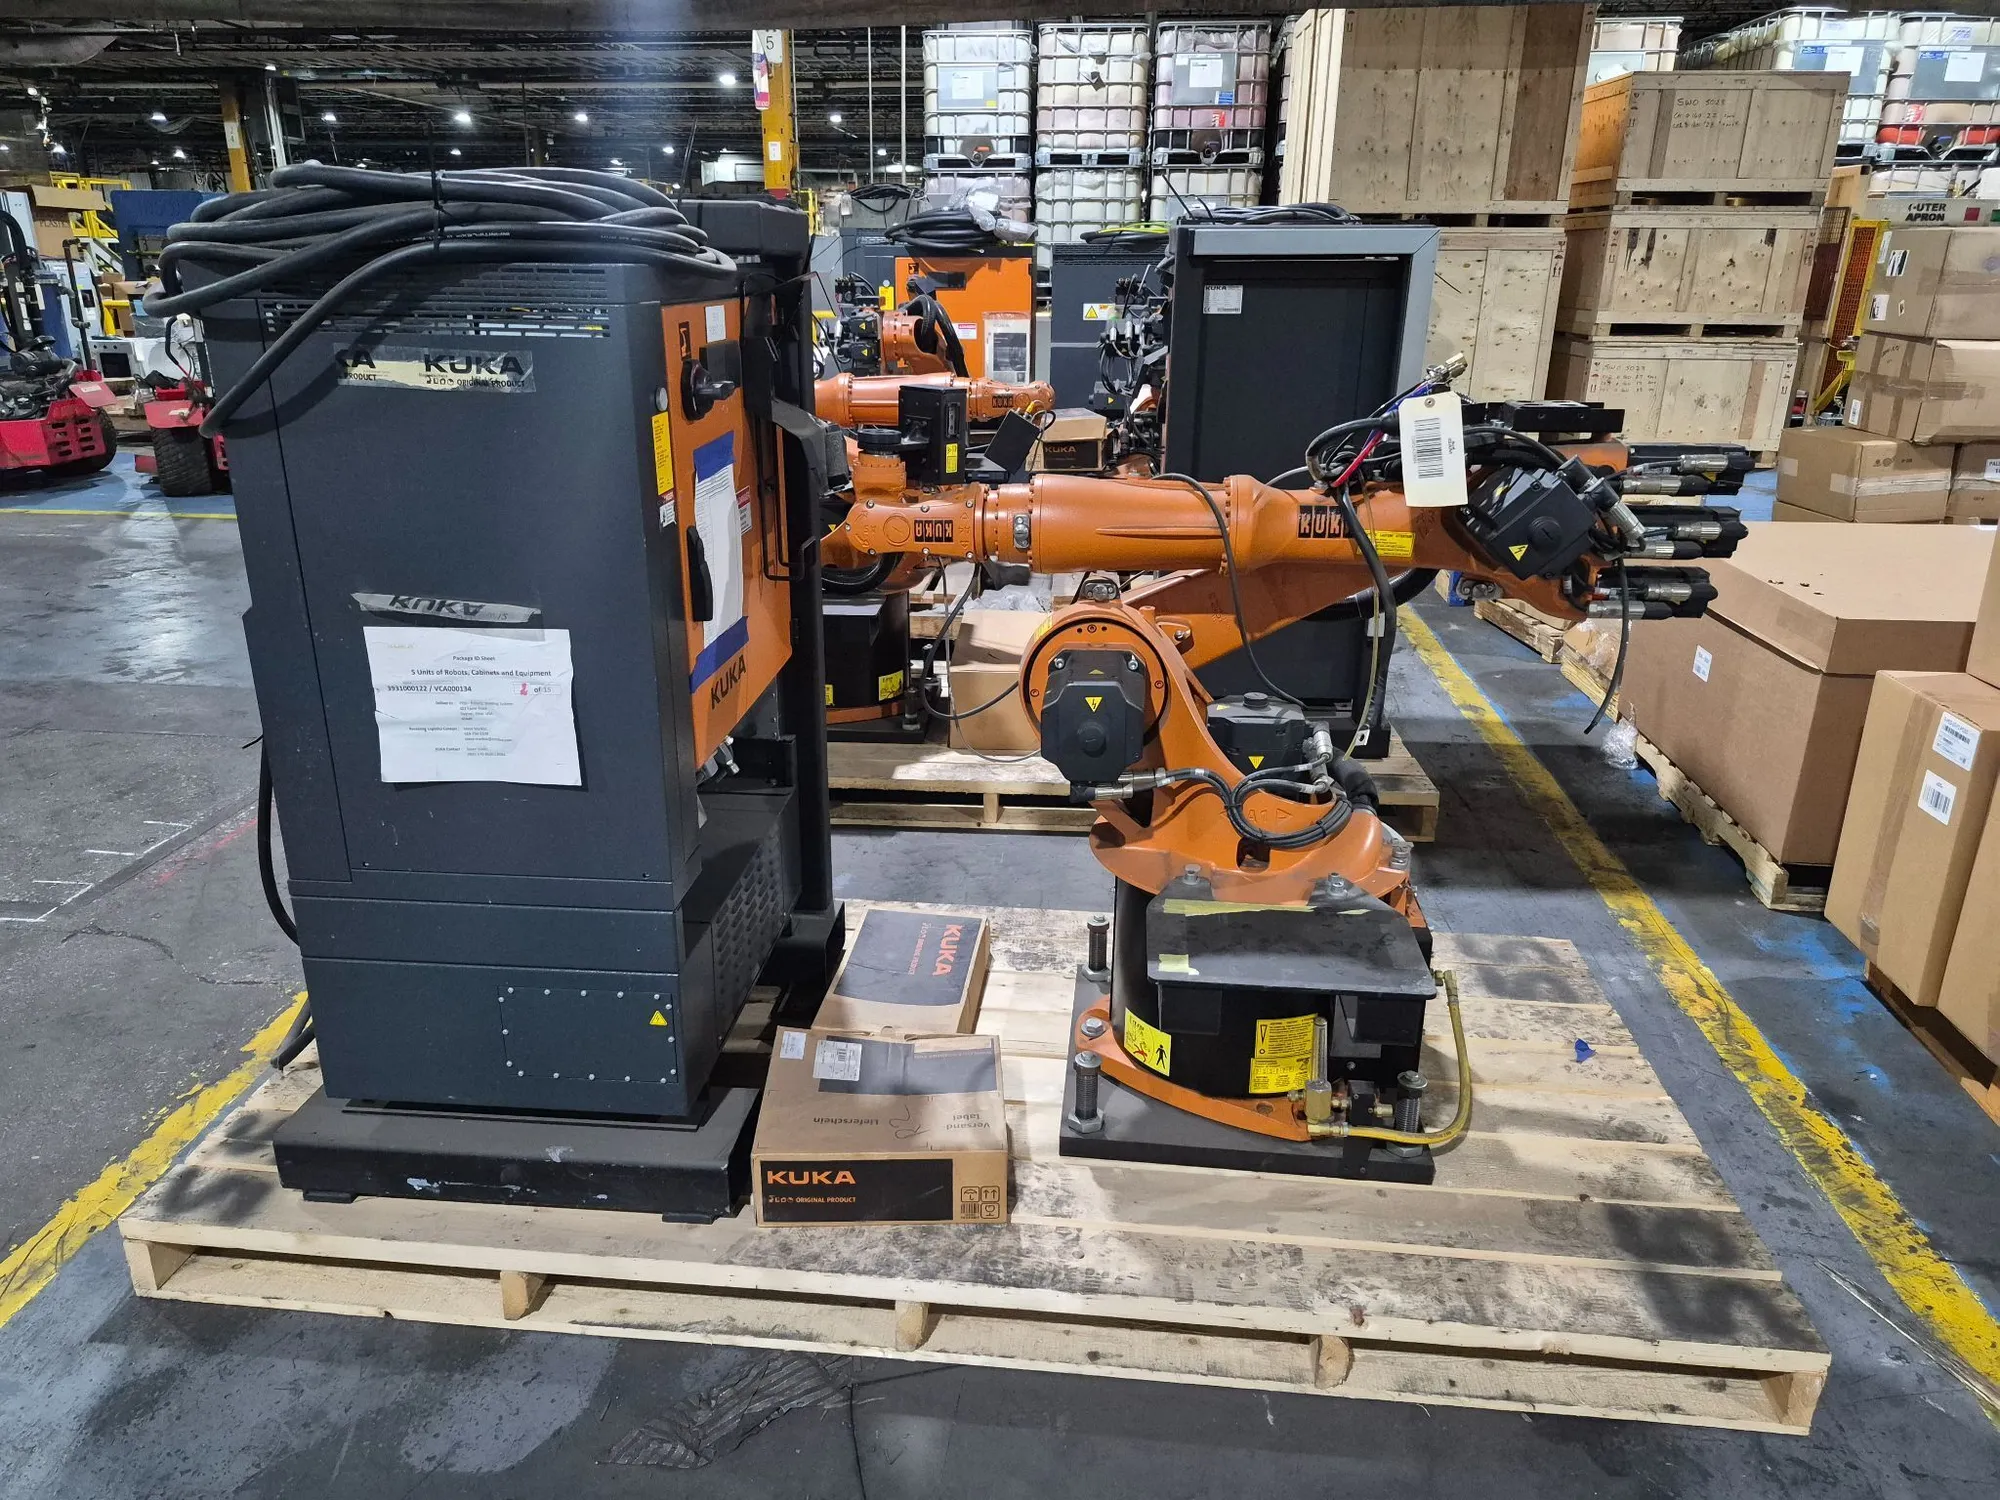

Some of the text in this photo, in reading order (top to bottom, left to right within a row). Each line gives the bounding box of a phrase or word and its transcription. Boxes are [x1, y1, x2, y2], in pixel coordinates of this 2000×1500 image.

[766, 35, 775, 50] 5
[1905, 212, 1945, 222] APRON
[424, 353, 525, 376] KUKA
[491, 379, 525, 388] PRODUCT
[992, 397, 1013, 407] KUKA
[1299, 512, 1350, 535] KUK
[916, 522, 953, 541] KUKA
[444, 669, 470, 677] Robots,
[515, 670, 552, 678] Equipment
[710, 653, 747, 710] KUKA
[931, 924, 964, 976] KUKA
[813, 1116, 880, 1126] Lieferschein
[767, 1170, 856, 1185] KUKA
